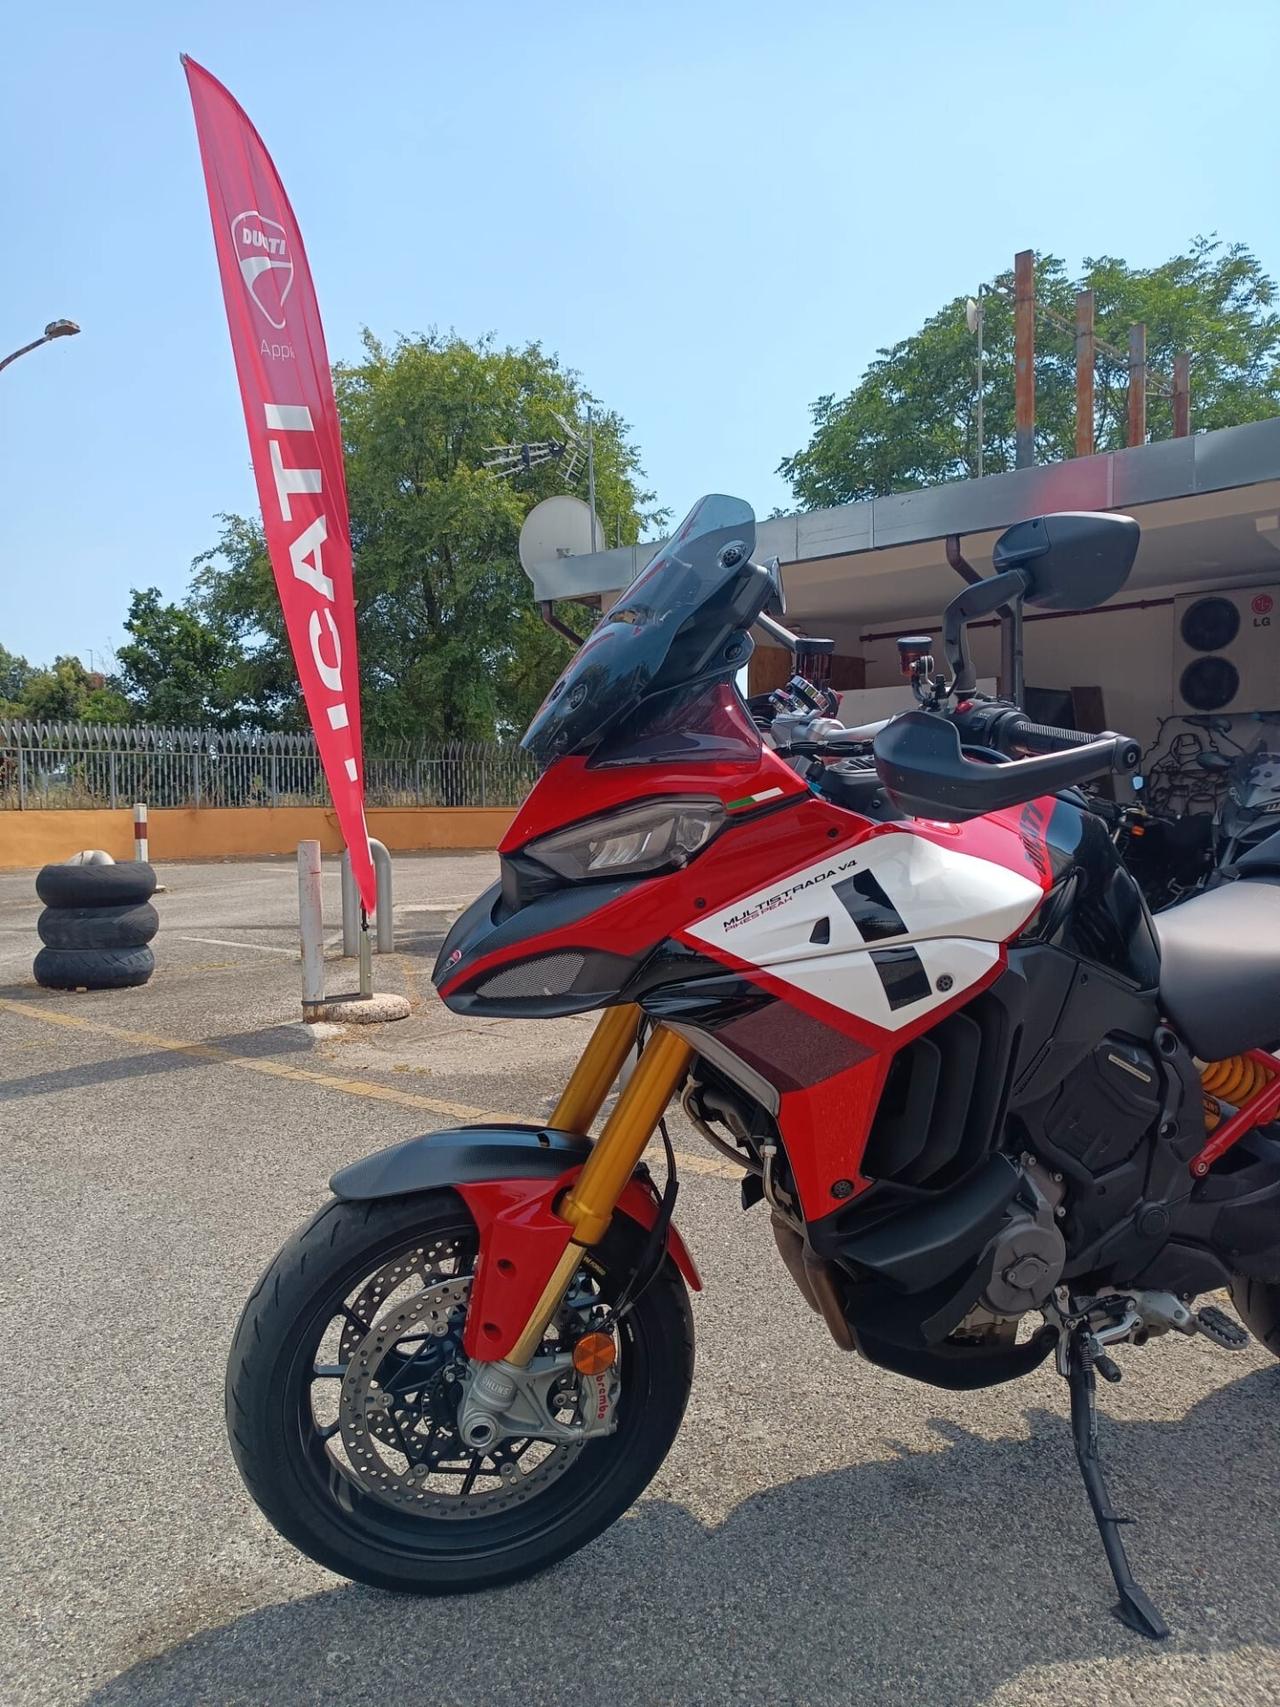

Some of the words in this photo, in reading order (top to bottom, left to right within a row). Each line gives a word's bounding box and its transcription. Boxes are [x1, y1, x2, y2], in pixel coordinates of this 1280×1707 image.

[1253, 616, 1271, 628] LG
[723, 869, 837, 928] MULTISTRADA
[838, 859, 858, 872] V4
[724, 912, 761, 933] PIKES
[761, 895, 793, 915] PEAK
[596, 1373, 609, 1420] brembo
